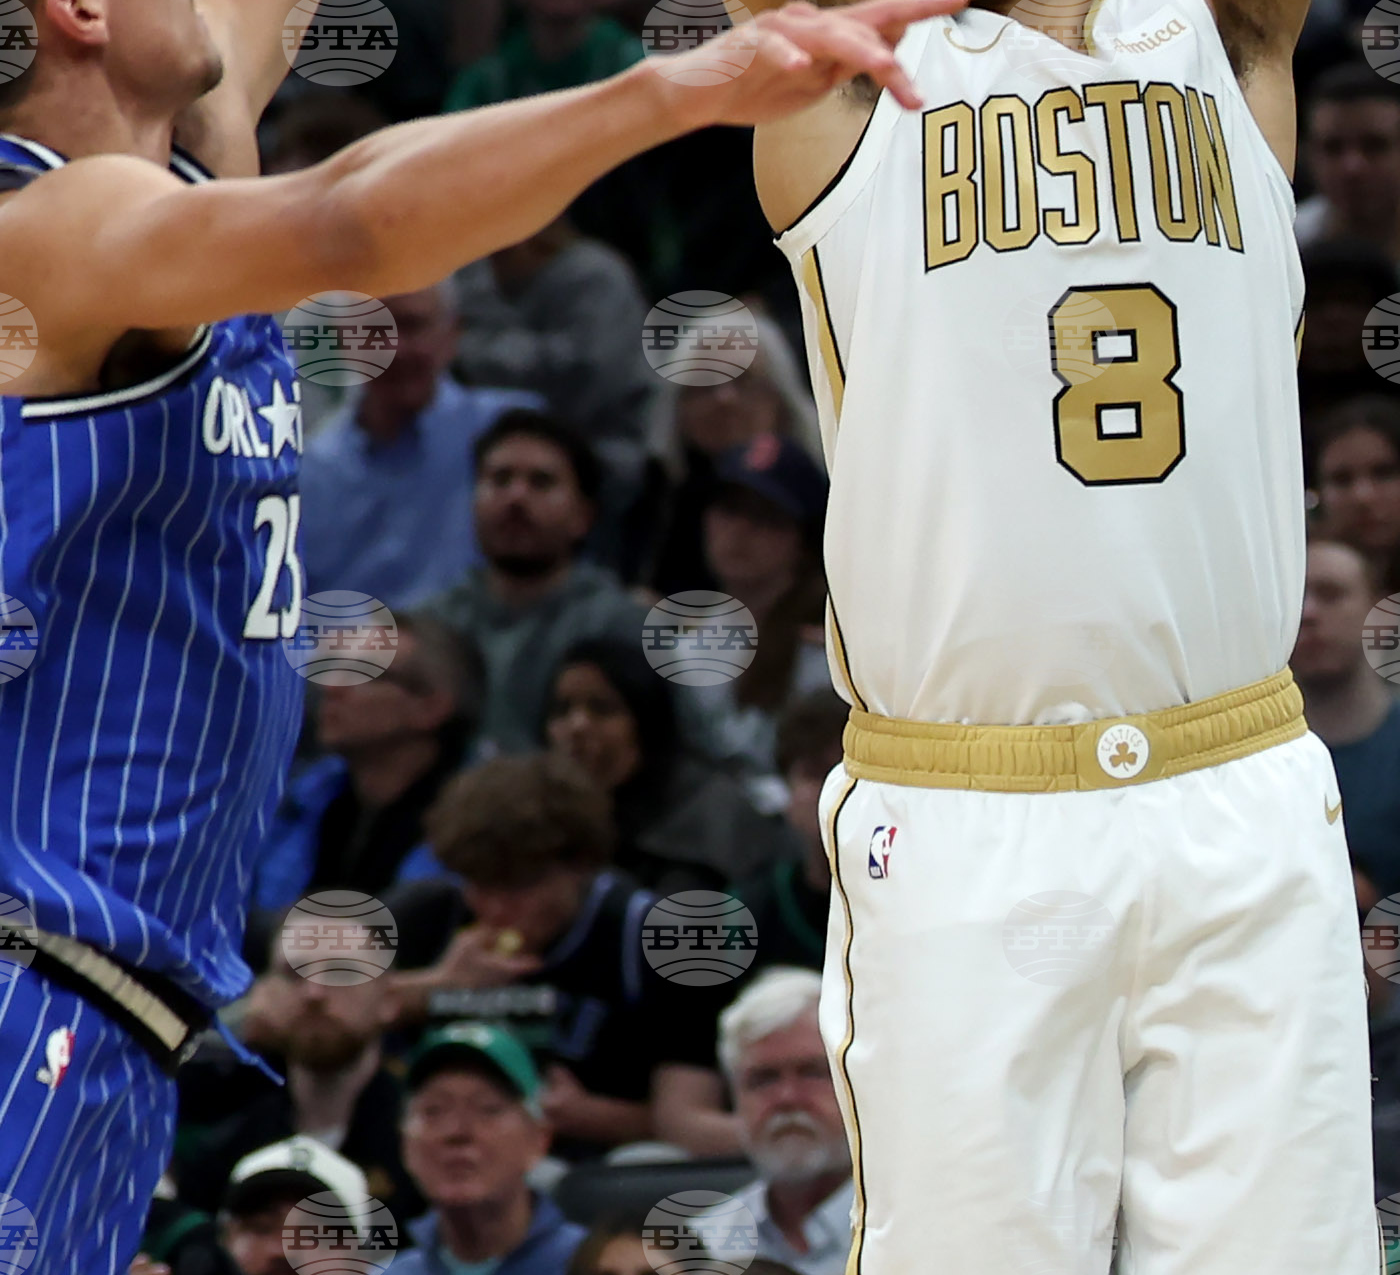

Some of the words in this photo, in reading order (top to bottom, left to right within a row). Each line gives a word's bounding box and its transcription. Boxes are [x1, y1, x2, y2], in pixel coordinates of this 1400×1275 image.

[1113, 17, 1187, 54] Amica
[922, 80, 1245, 274] BOSTON
[1047, 282, 1186, 487] 8
[1101, 728, 1143, 752] CELTICS
